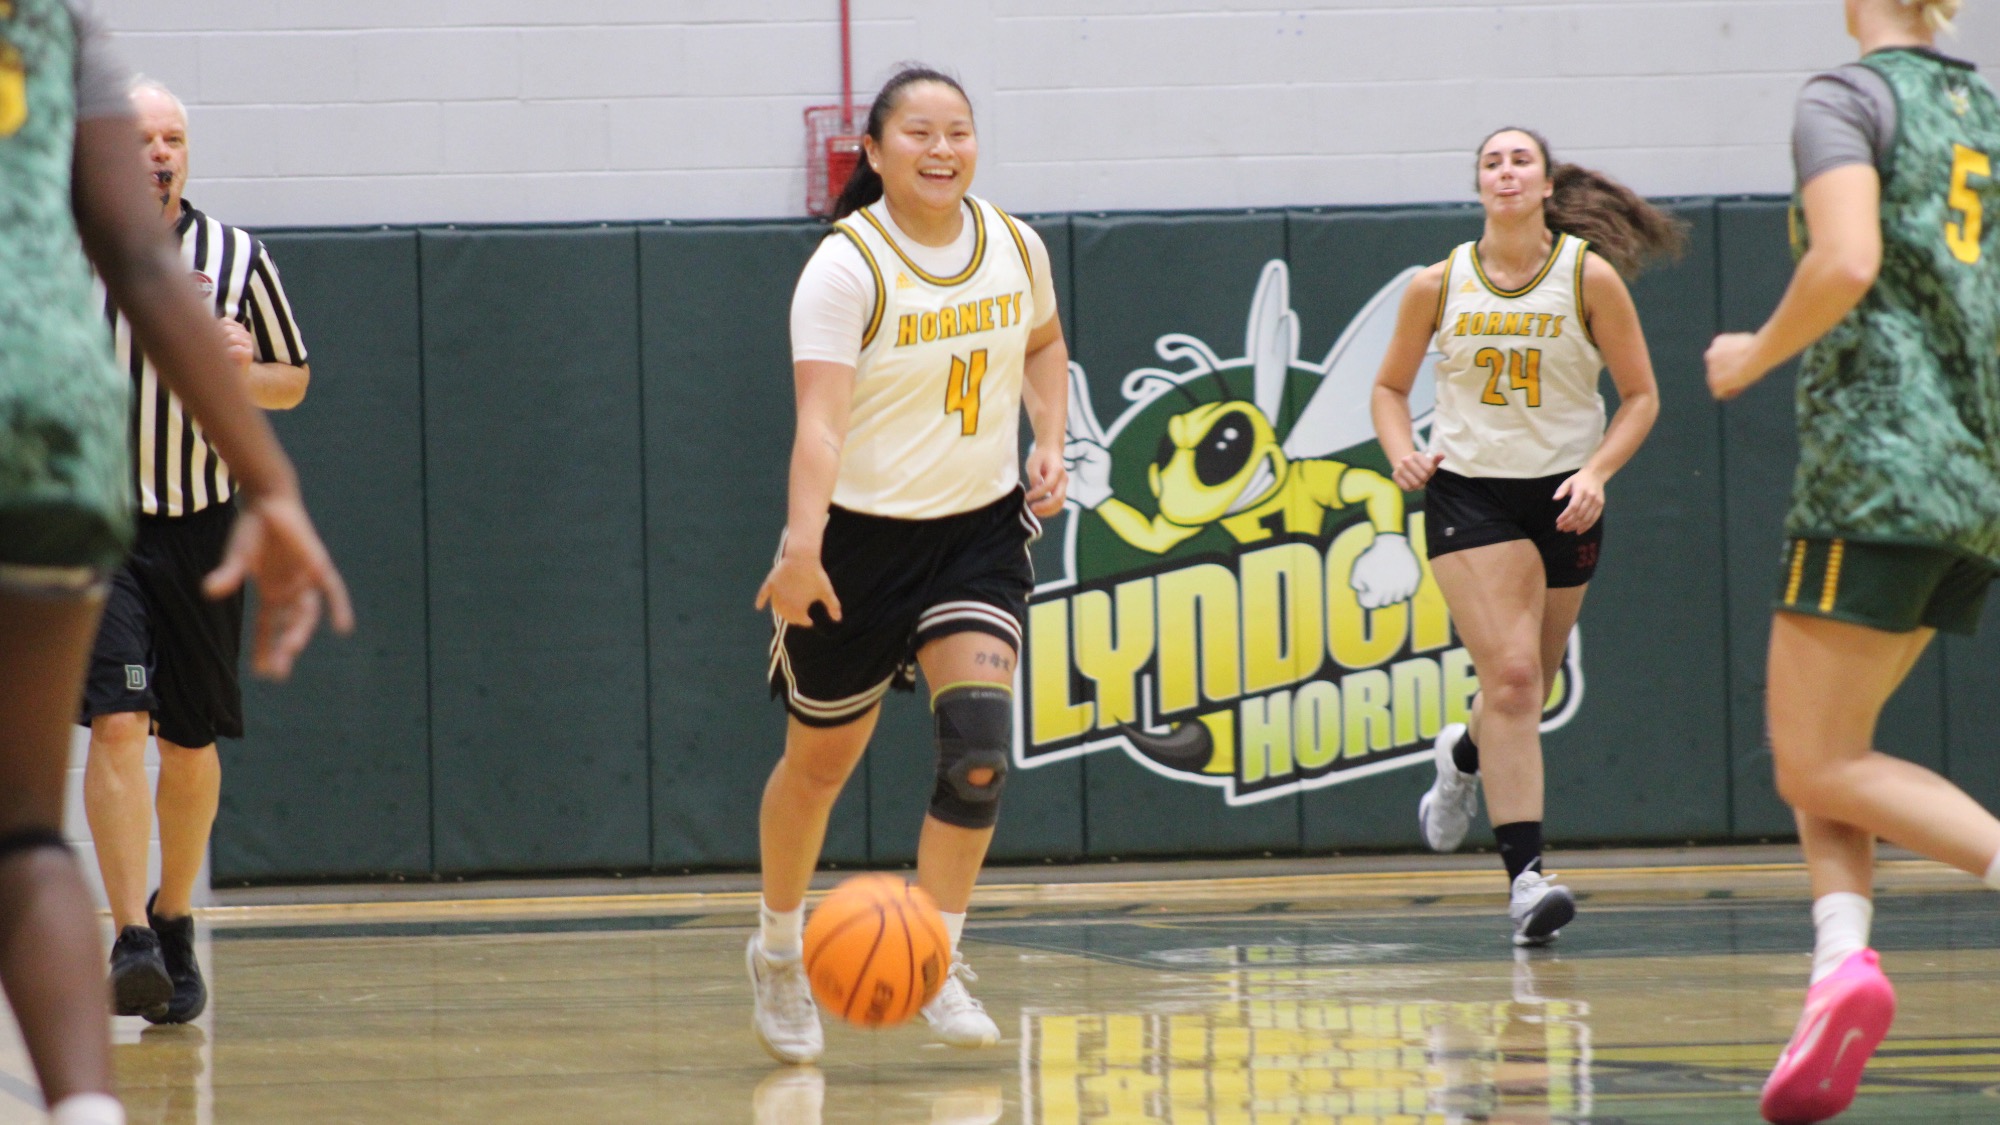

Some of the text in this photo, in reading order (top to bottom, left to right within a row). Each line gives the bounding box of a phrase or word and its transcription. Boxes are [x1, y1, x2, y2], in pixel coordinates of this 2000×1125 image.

[1945, 142, 1992, 265] 5
[894, 291, 1023, 347] HORNETS
[1453, 311, 1567, 338] HORNETS
[945, 348, 988, 437] 4
[1474, 346, 1542, 408] 24
[124, 664, 148, 690] D
[1241, 646, 1565, 784] HORNE
